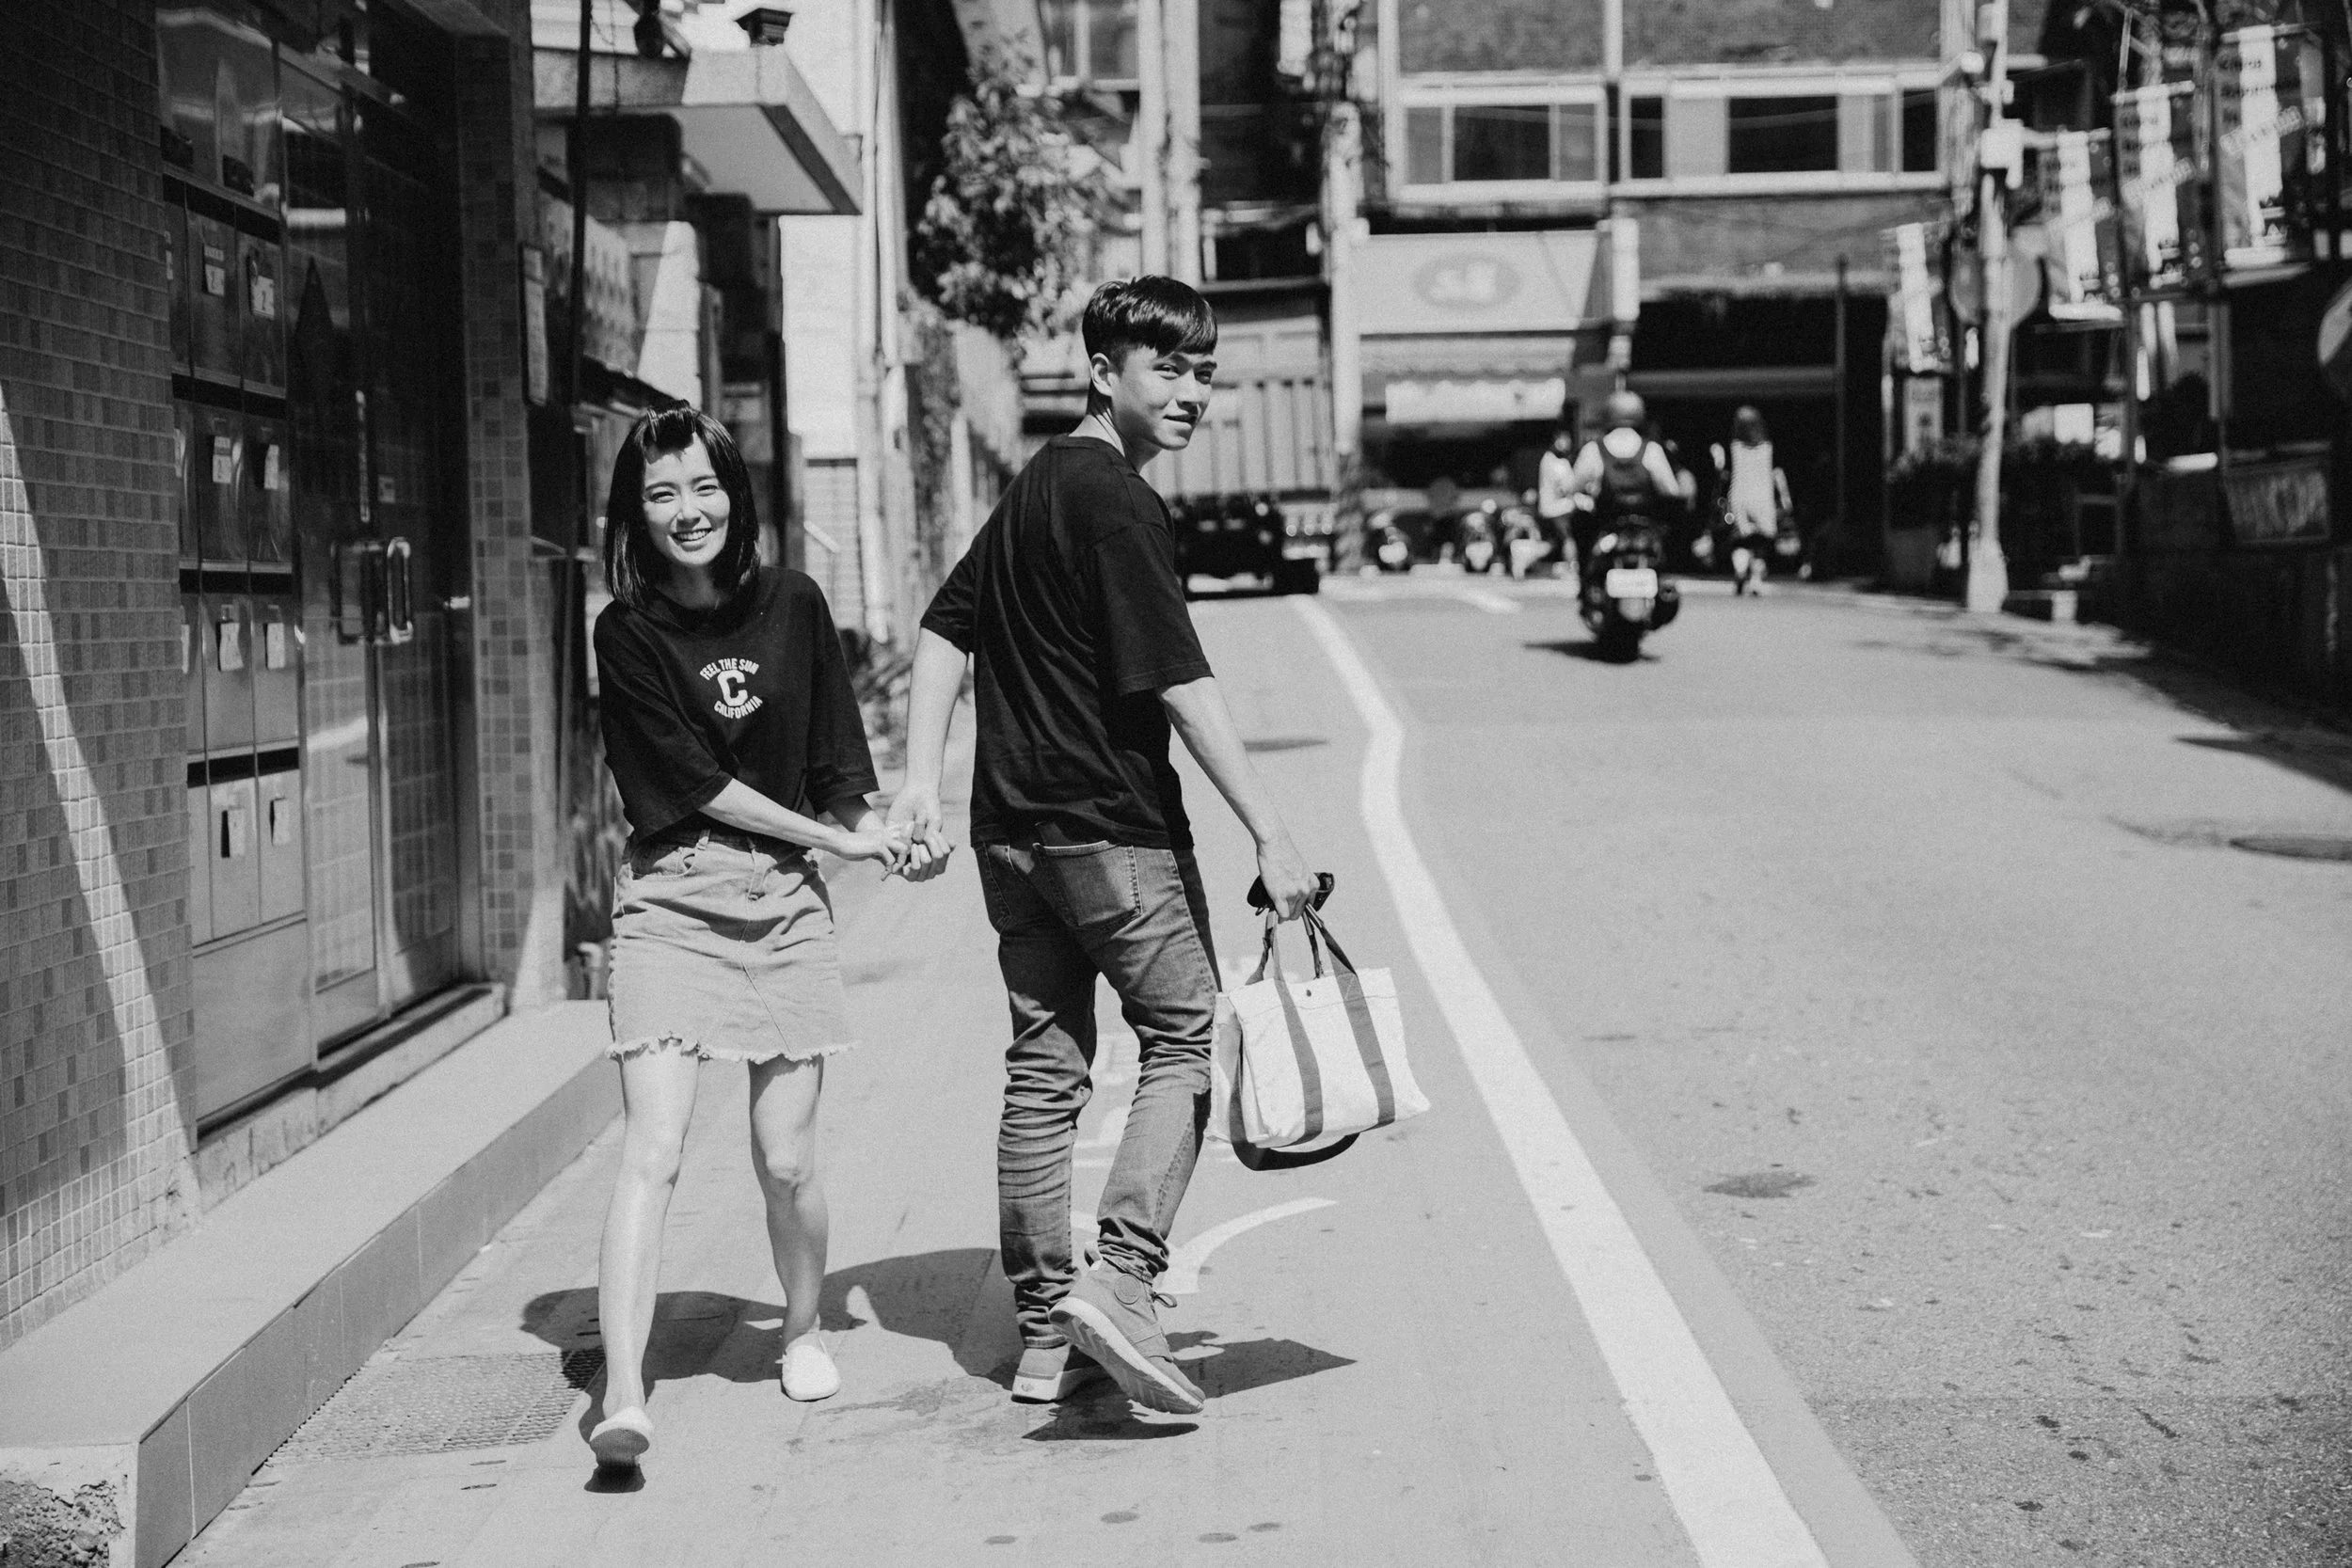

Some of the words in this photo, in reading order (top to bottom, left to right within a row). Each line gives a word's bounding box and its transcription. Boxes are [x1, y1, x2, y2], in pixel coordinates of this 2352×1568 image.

[700, 662, 721, 680] FEEL
[718, 658, 738, 671] THE
[739, 658, 759, 674] SUN
[718, 670, 748, 706] C
[714, 696, 763, 719] CALIFORNIA
